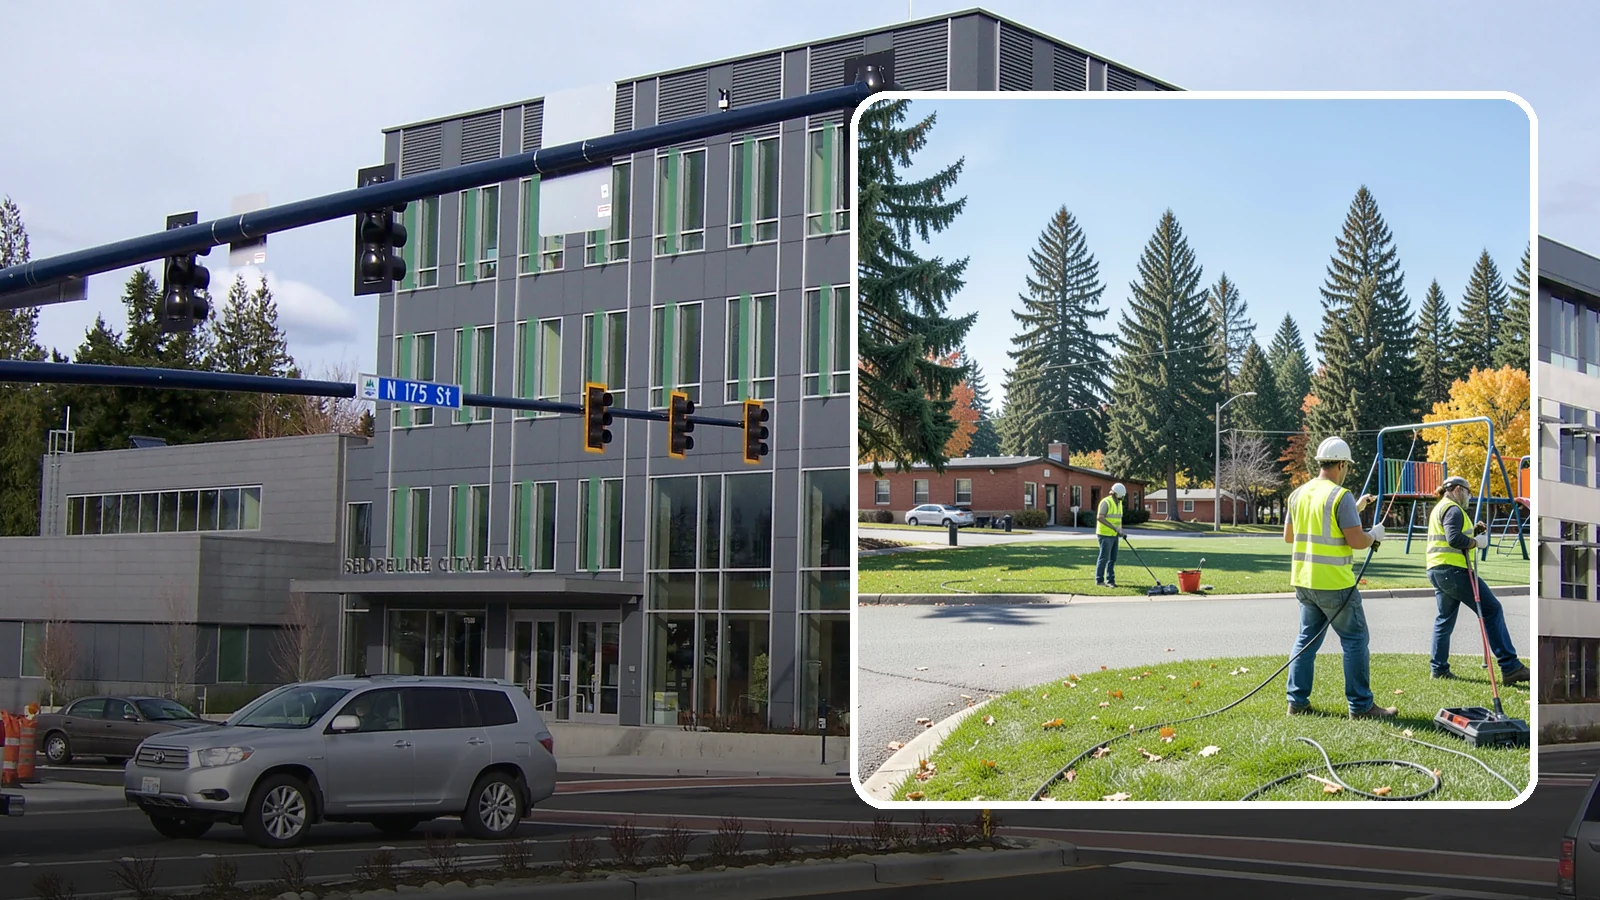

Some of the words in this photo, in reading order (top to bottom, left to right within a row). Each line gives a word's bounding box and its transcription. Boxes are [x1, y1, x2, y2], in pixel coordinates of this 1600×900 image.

[387, 380, 396, 399] N
[405, 382, 427, 403] 175
[436, 386, 451, 405] St
[344, 557, 432, 574] SHORELINE
[438, 556, 475, 572] CITY
[484, 555, 525, 571] HALL
